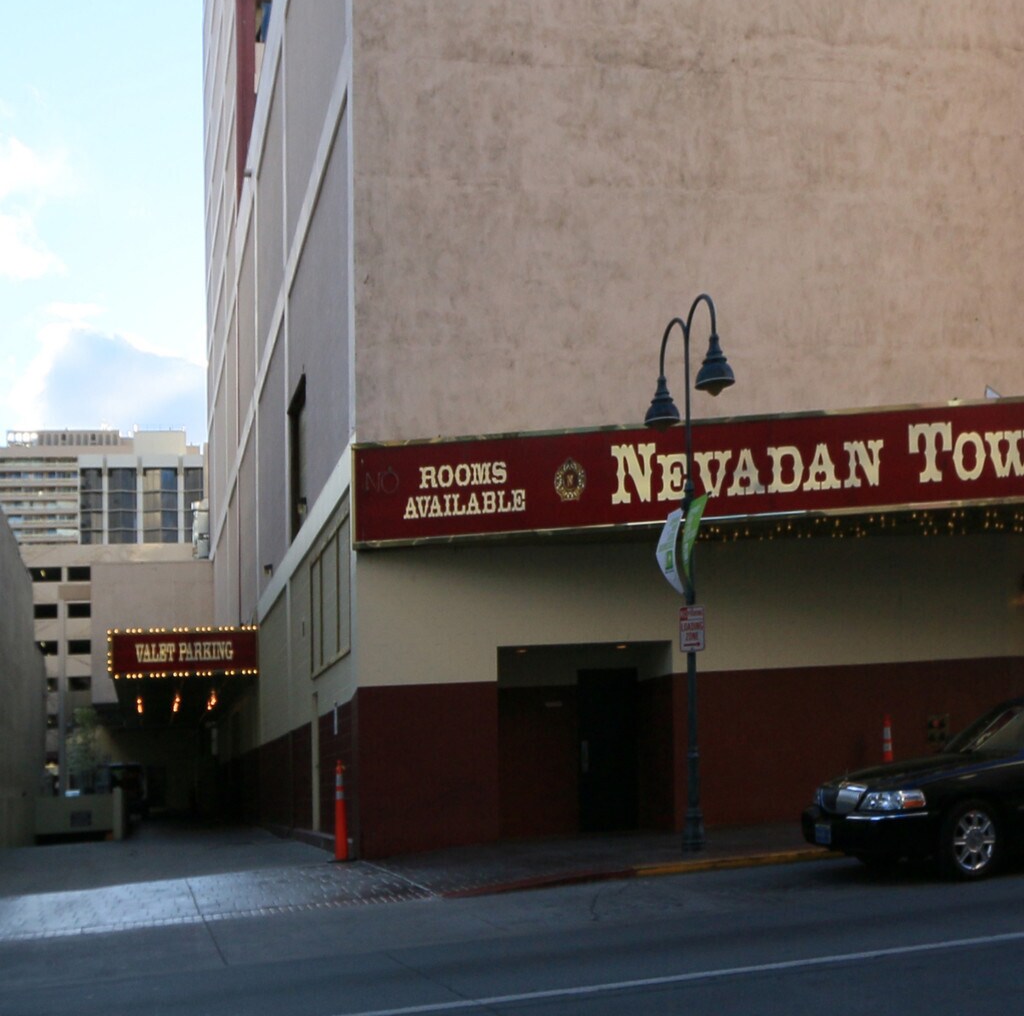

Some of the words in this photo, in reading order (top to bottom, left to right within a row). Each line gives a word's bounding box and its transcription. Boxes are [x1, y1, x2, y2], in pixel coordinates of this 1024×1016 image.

[419, 461, 508, 489] ROOMS
[611, 440, 884, 505] NEVADAN
[403, 489, 526, 520] AVAILABLE
[135, 643, 176, 663] VALET
[178, 641, 234, 662] PARKING
